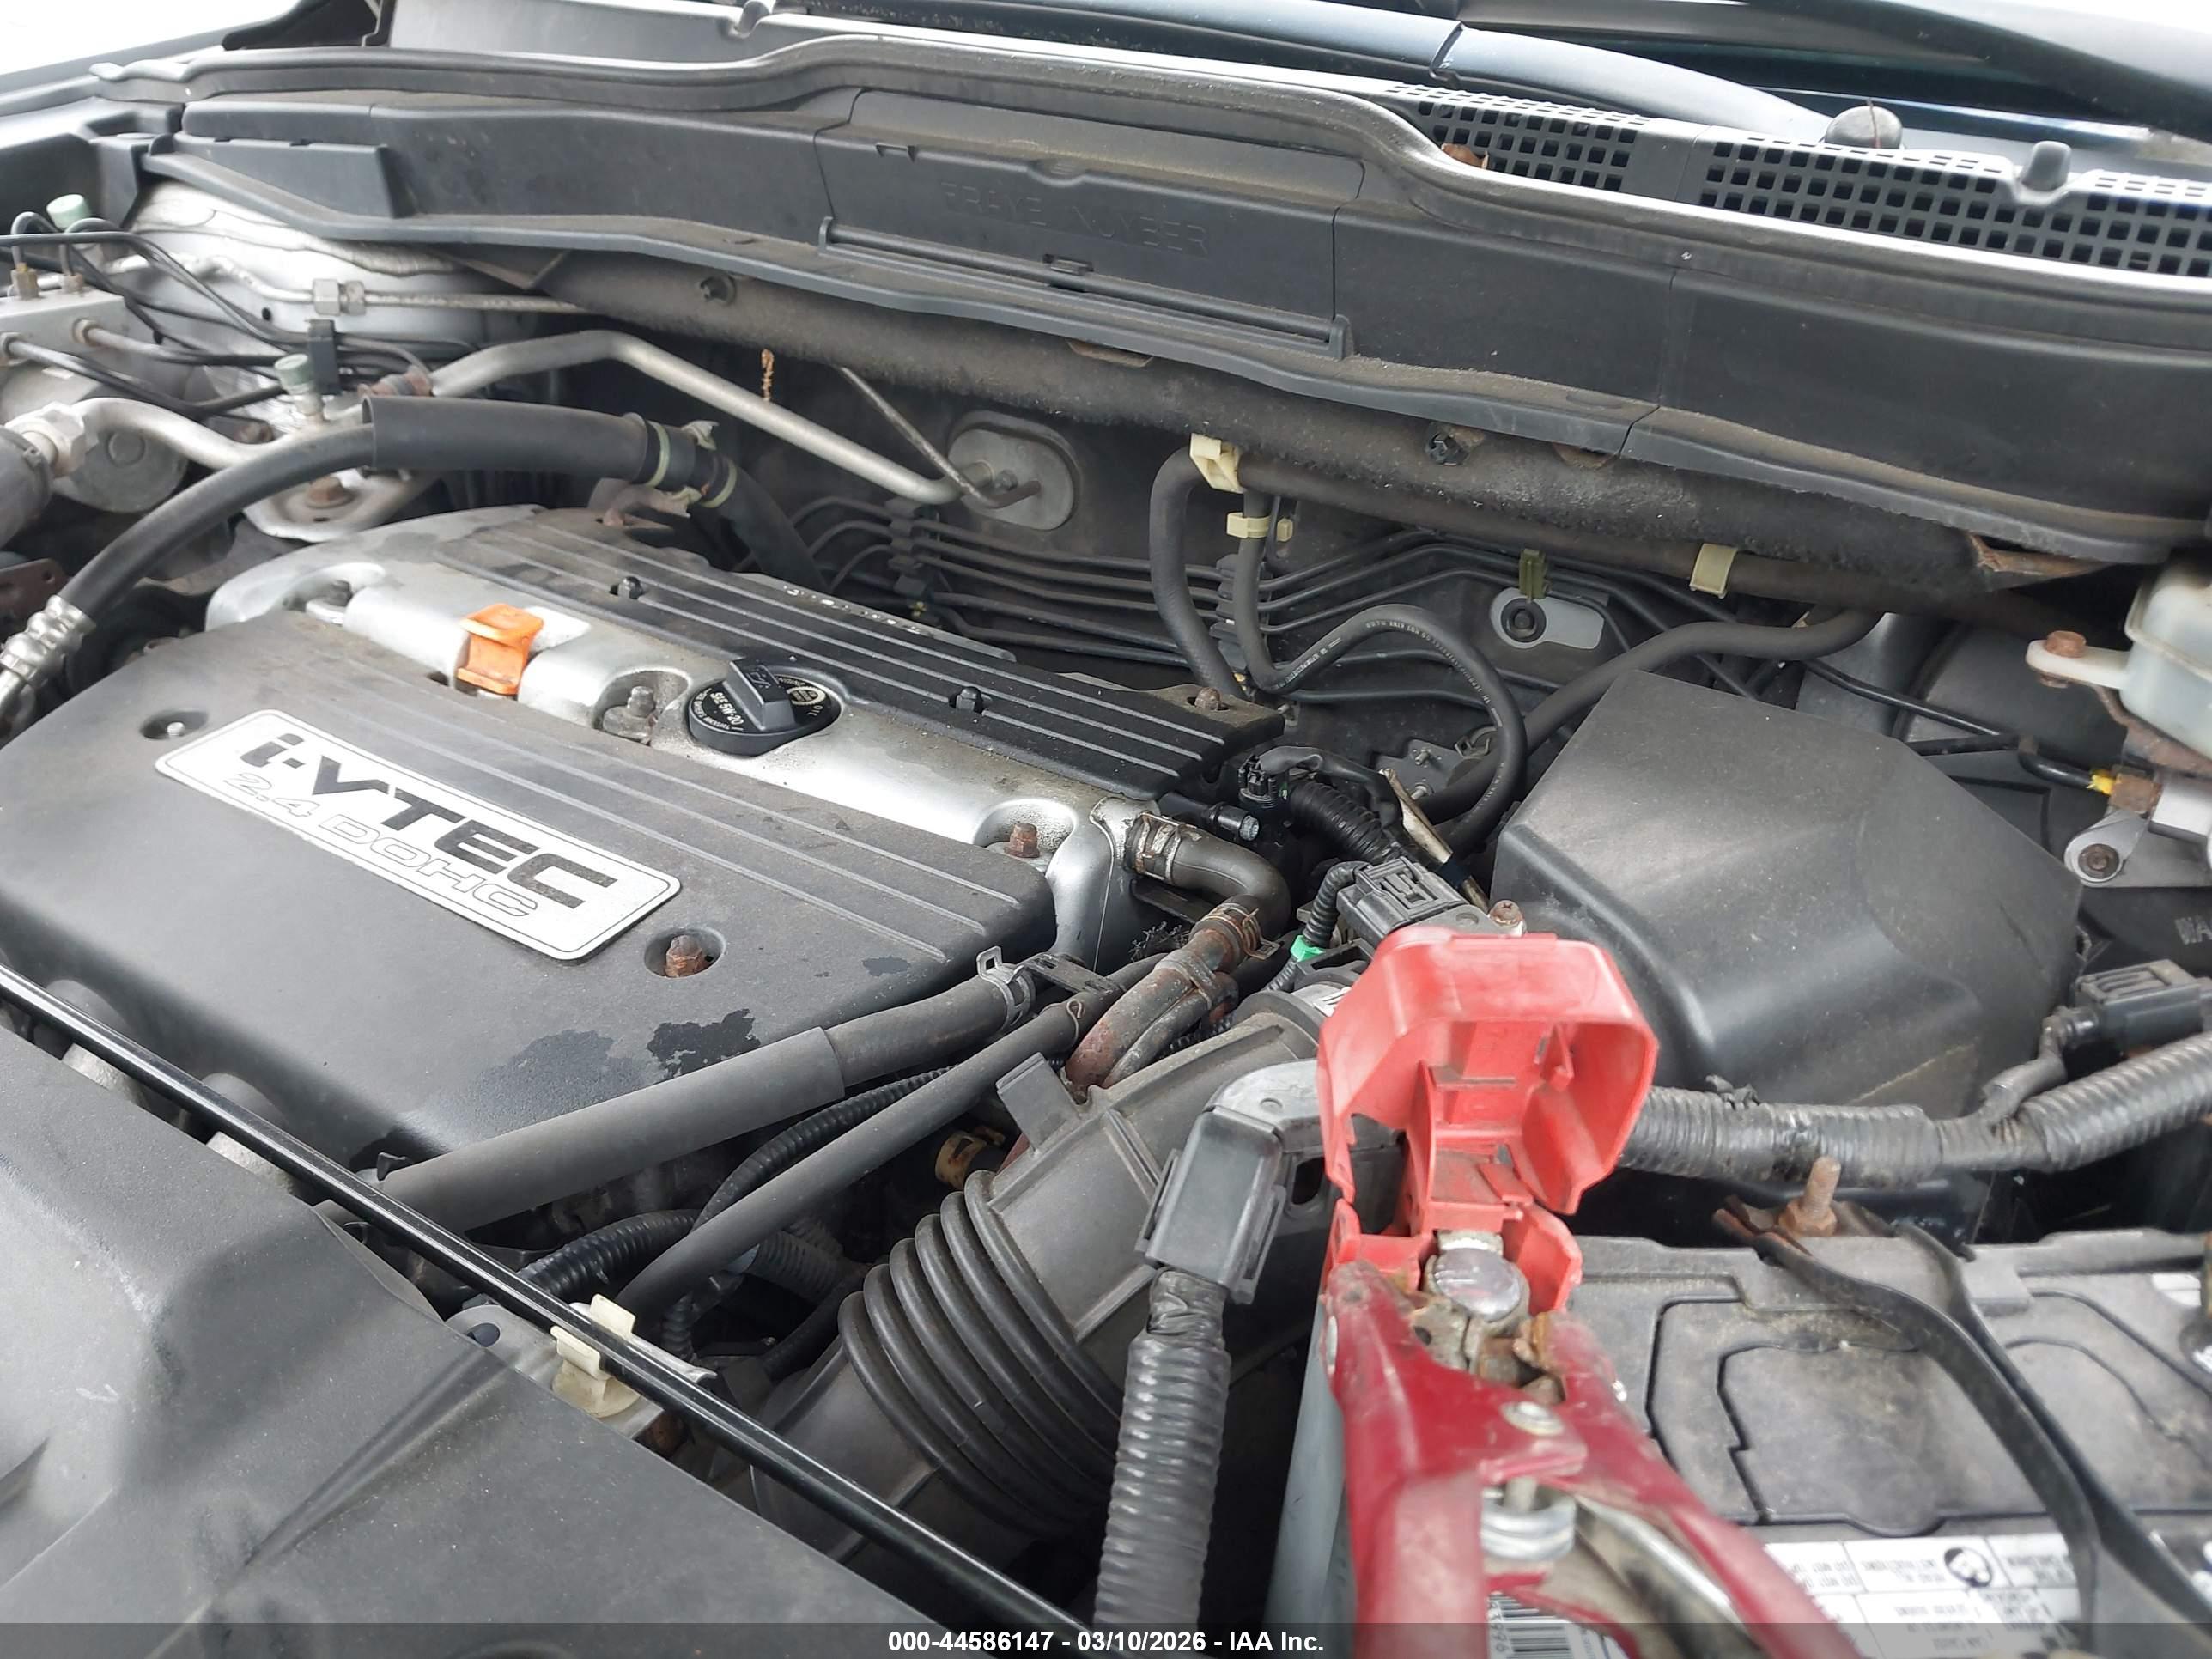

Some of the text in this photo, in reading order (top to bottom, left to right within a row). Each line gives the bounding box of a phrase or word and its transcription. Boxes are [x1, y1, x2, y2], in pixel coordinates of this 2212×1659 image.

[718, 702, 744, 725] 5W-20
[222, 772, 539, 917] 2.4 DOHC
[240, 732, 617, 910] i-VTEC
